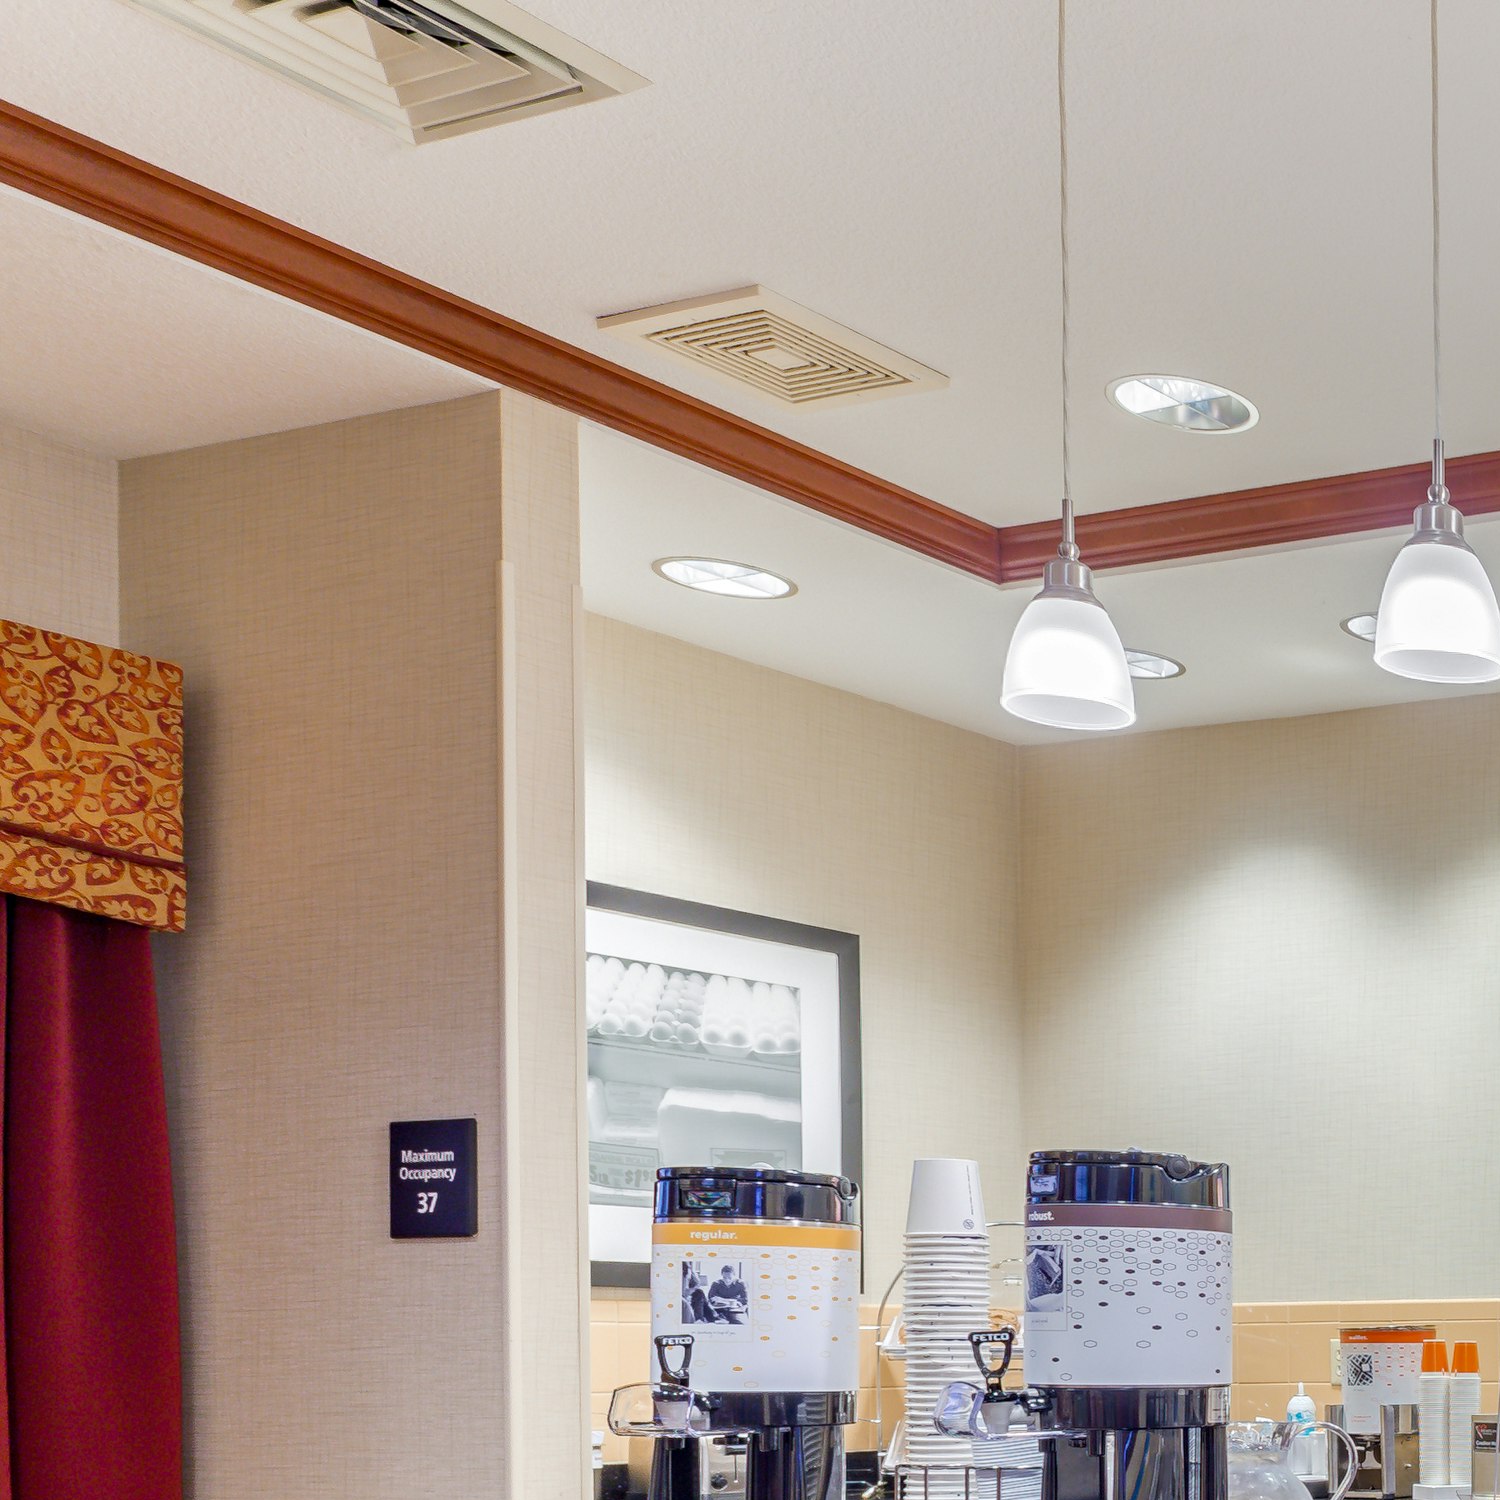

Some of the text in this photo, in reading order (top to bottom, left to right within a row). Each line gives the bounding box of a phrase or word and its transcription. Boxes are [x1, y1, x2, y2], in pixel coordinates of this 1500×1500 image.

[401, 1149, 455, 1163] Maximum
[399, 1167, 457, 1182] Occupancy
[416, 1192, 438, 1213] 37
[1028, 1210, 1055, 1221] robust.
[689, 1229, 738, 1241] regular.
[662, 1337, 692, 1345] FETCO
[972, 1333, 1009, 1342] FETCO
